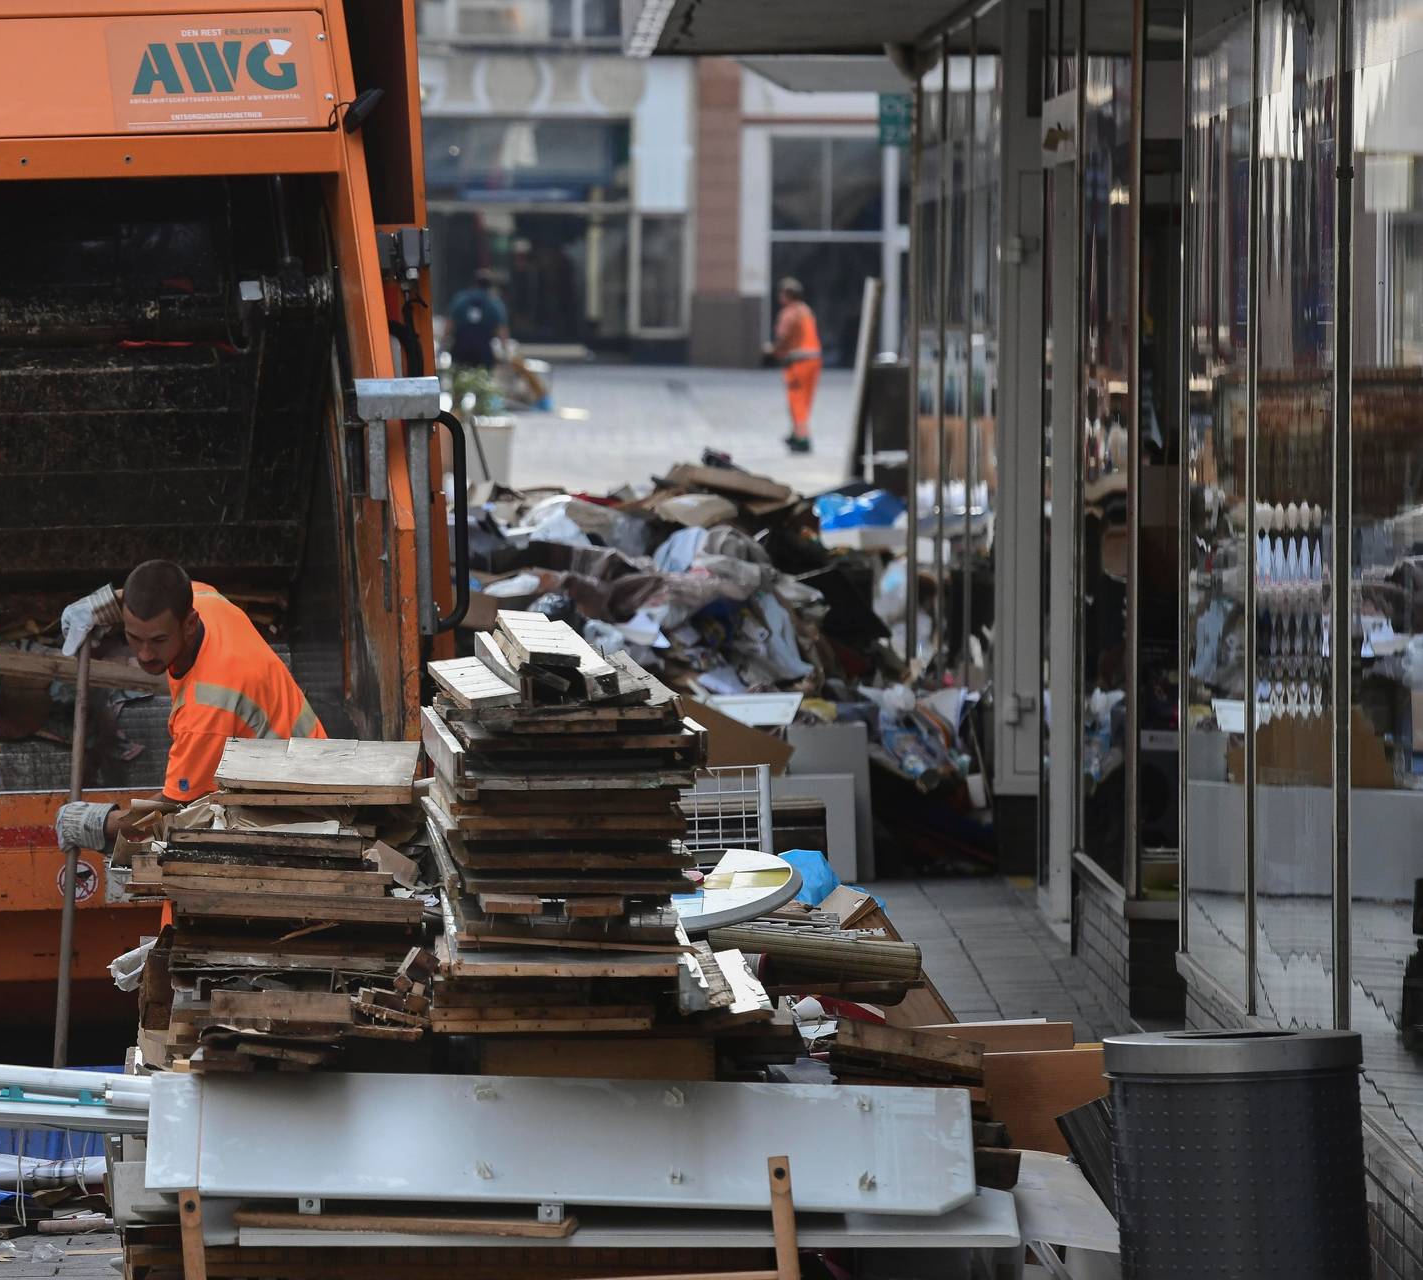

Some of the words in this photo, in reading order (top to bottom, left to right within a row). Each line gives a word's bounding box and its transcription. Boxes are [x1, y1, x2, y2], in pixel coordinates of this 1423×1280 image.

[181, 29, 199, 37] DEN
[201, 28, 222, 36] REST
[225, 27, 271, 36] ERLEDIGEN
[132, 39, 298, 95] AWG
[129, 96, 245, 104] ABFALLWIRTSCHAFTSGESELLSCHAFT
[171, 112, 263, 121] ENTSORGUNGSFACHBETRIEB
